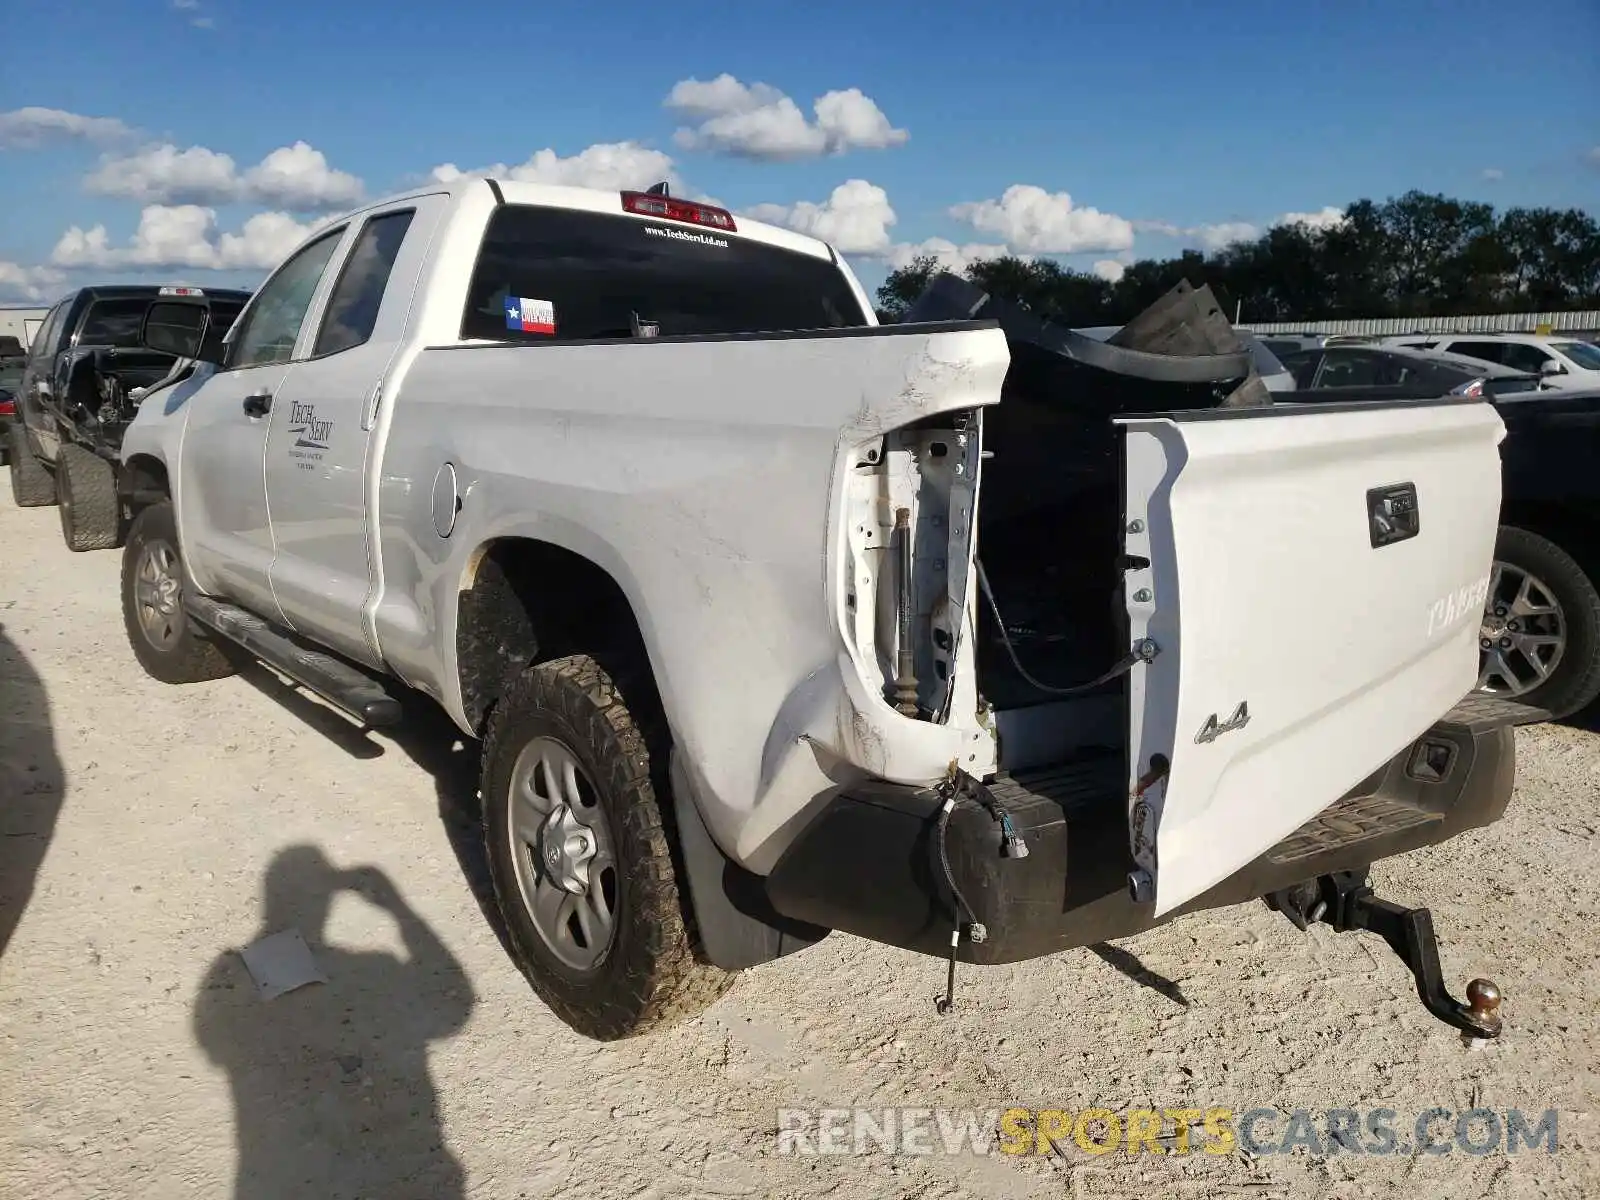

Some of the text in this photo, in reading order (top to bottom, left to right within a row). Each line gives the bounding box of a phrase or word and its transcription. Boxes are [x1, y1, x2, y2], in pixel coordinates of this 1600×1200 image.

[645, 226, 729, 248] www.TechServLtd.net
[290, 400, 314, 424] TECH
[308, 416, 333, 441] SERV
